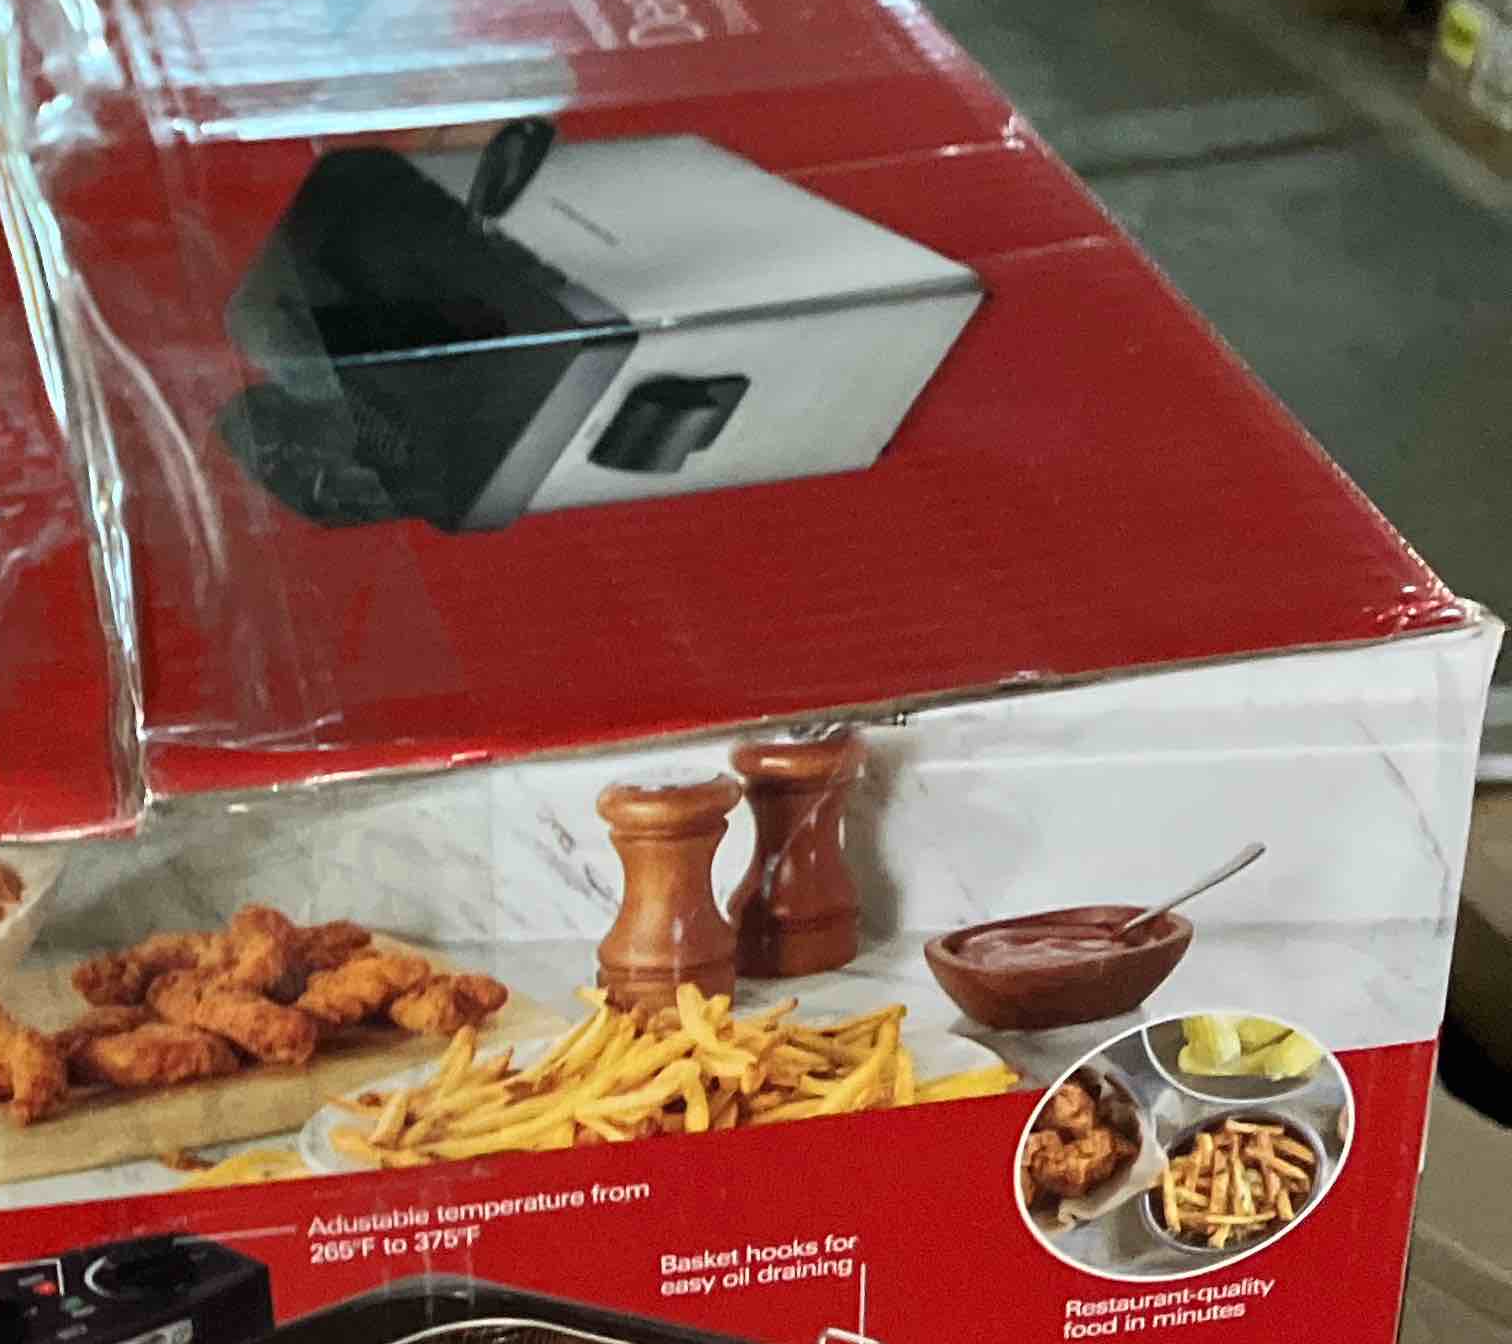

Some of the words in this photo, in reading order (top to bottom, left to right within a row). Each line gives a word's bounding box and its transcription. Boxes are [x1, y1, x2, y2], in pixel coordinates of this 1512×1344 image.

[437, 1188, 585, 1224] temperature
[591, 1181, 651, 1203] from
[383, 1236, 408, 1256] to
[660, 1247, 740, 1275] Basket
[746, 1239, 819, 1263] hooks
[824, 1233, 859, 1254] for
[660, 1273, 716, 1297] easy
[722, 1267, 751, 1288] oil
[757, 1257, 854, 1285] draining
[1064, 1277, 1276, 1319] Restaurant-quality
[1063, 1317, 1118, 1340] food
[1124, 1314, 1146, 1332] in
[1152, 1302, 1246, 1329] minutes
